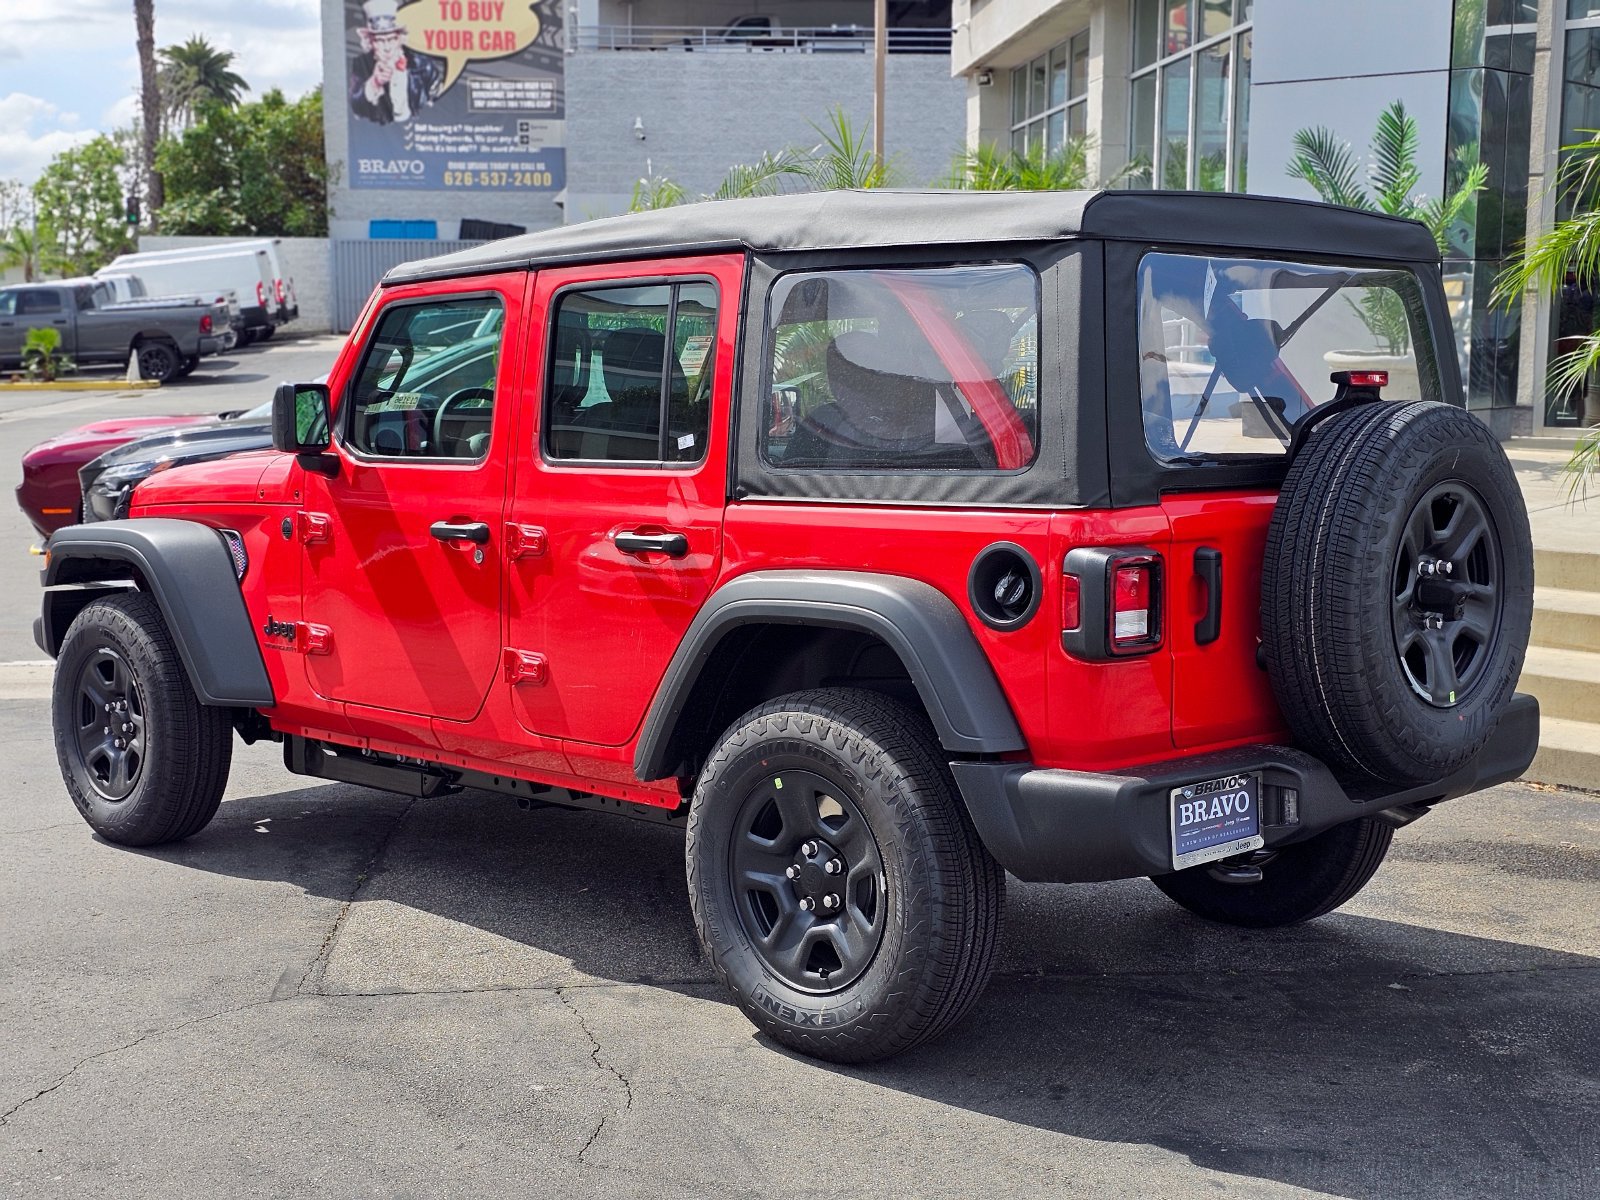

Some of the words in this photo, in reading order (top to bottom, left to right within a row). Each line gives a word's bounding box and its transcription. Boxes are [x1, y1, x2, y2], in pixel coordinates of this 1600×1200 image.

[439, 0, 462, 21] TO
[467, 0, 505, 21] BUY
[424, 29, 474, 51] YOUR
[478, 30, 517, 52] CAR
[357, 158, 425, 175] BRAVO
[443, 171, 553, 186] 626-537-2400
[263, 614, 297, 642] Jeep
[1194, 776, 1240, 796] BRAVO
[1179, 790, 1250, 827] BRAVO
[1235, 840, 1251, 851] Jeep
[762, 993, 855, 1026] NEXEN
